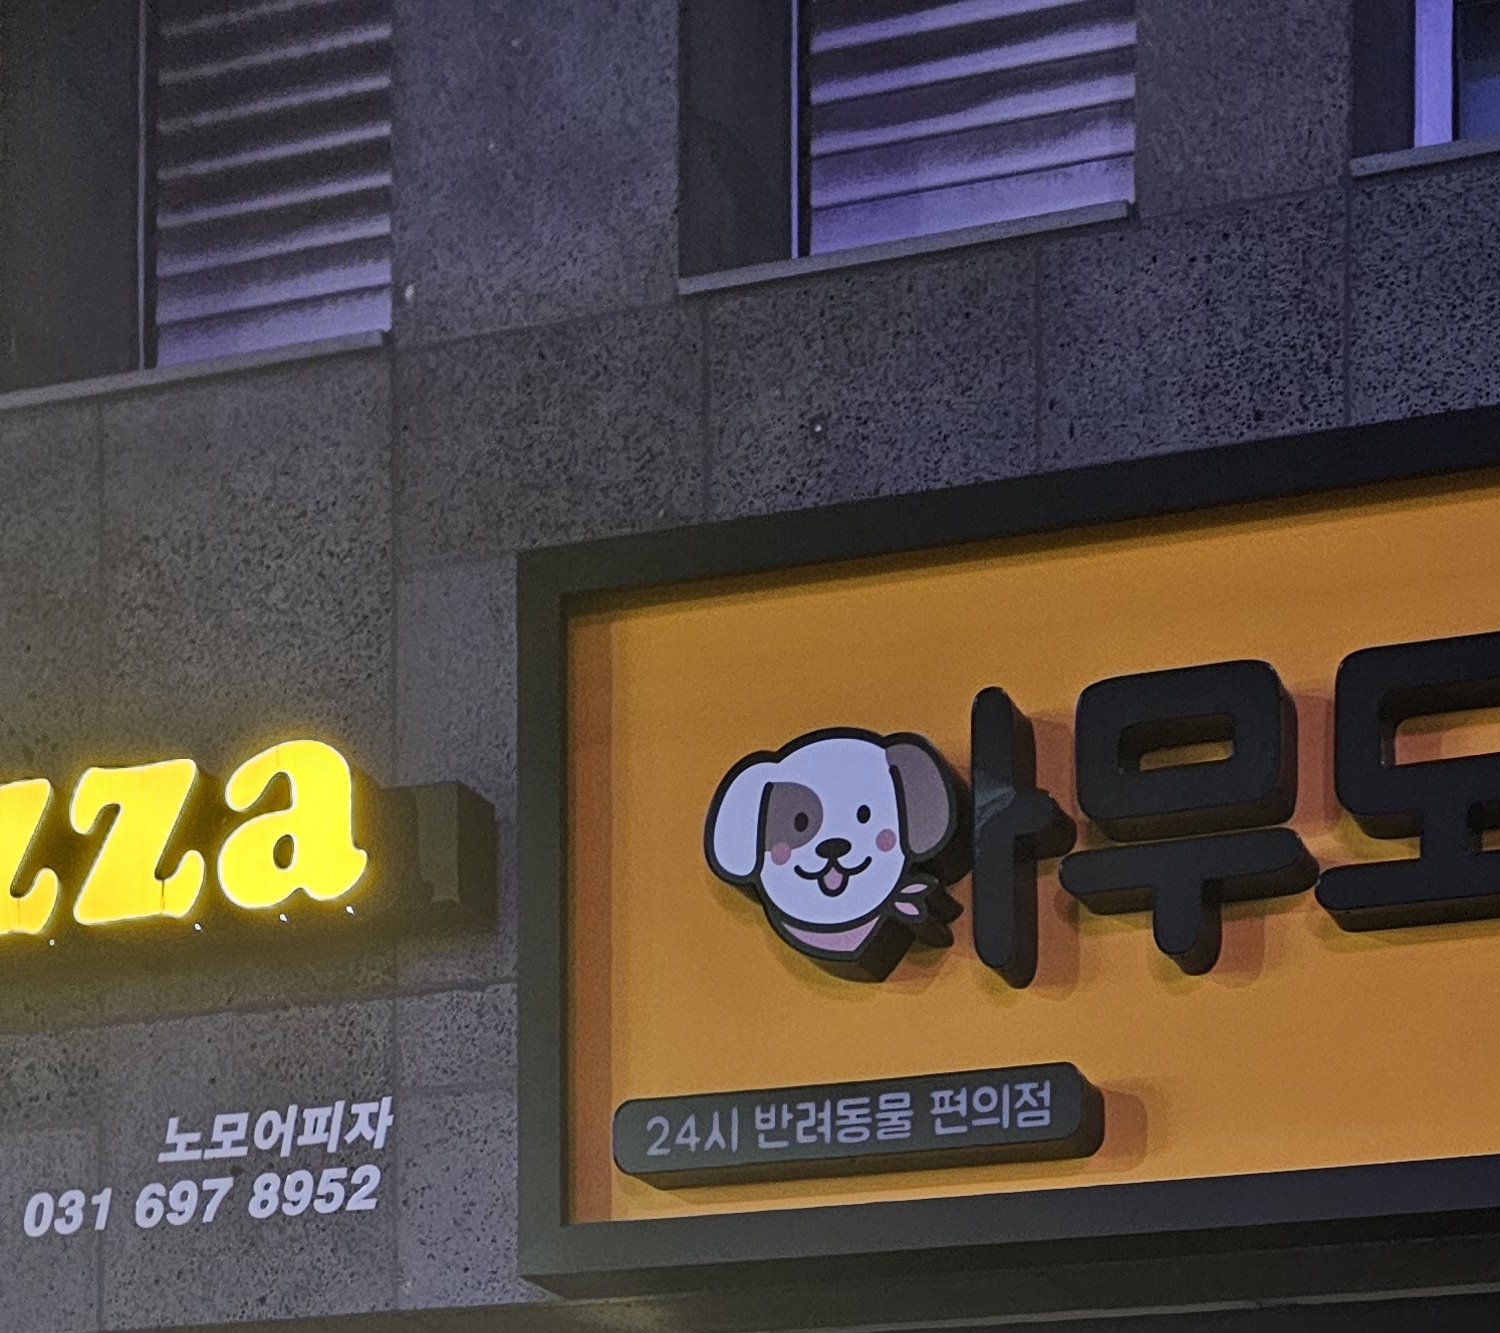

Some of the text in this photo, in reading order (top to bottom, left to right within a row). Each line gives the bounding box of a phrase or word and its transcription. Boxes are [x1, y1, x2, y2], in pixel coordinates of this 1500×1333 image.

[158, 1097, 393, 1163] 노모어피자
[646, 1081, 1052, 1156] 24시 반려동물 편의점
[23, 1165, 380, 1237] 031 697 8952
